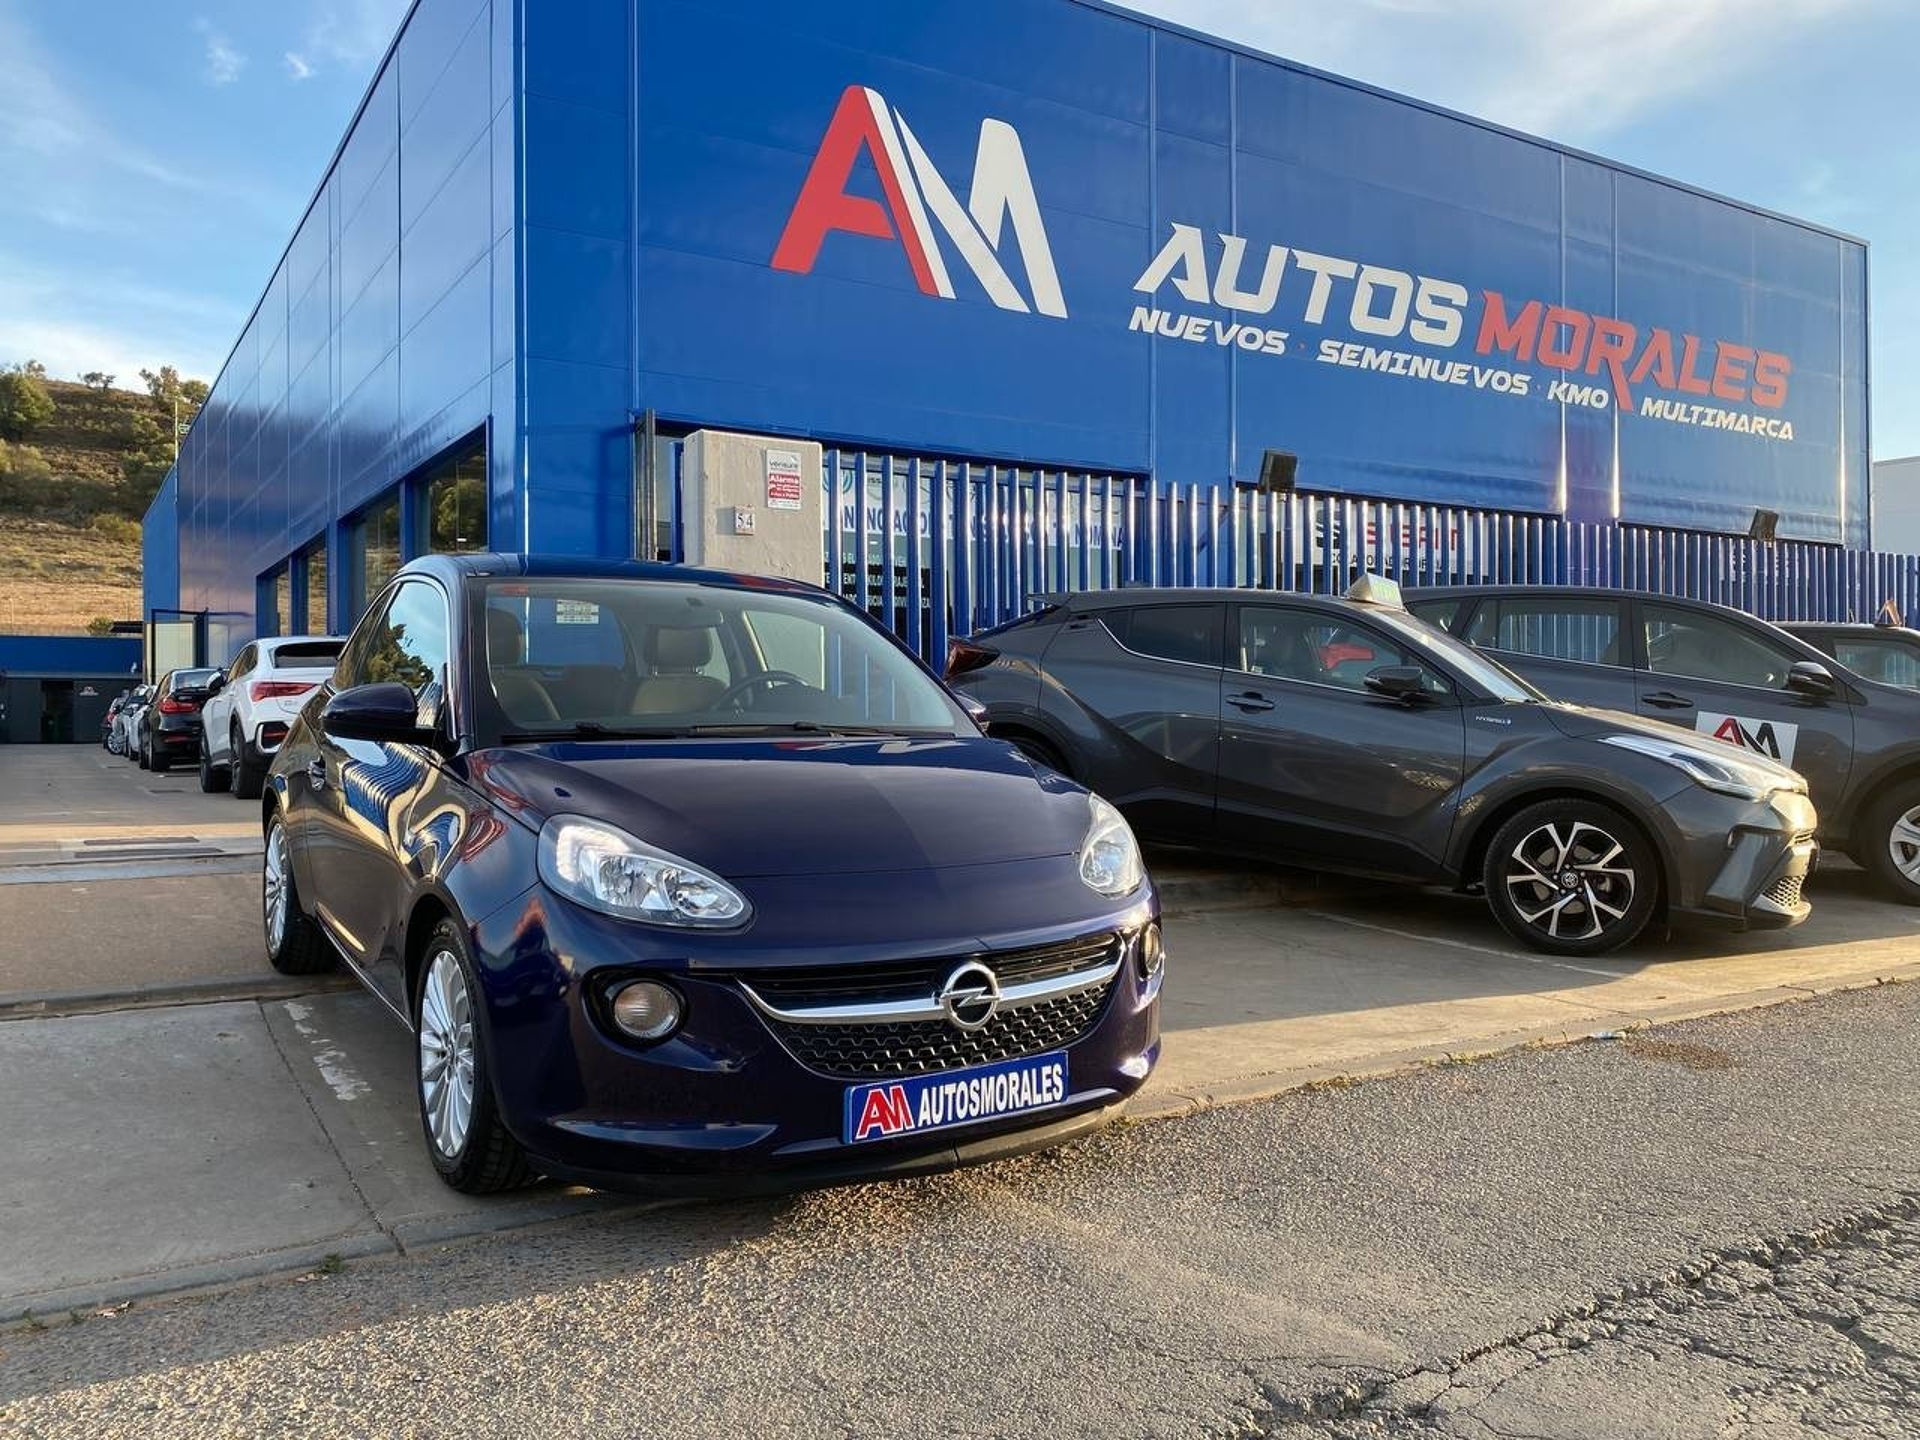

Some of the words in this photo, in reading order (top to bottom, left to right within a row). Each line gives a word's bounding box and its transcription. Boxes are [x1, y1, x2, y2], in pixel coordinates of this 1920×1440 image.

[769, 84, 1069, 318] AM
[1128, 306, 1290, 355] NUEVOS
[1316, 339, 1532, 396] SEMINUEVOS
[1640, 396, 1795, 441] MULTIMARCA
[1132, 221, 1469, 348] AUTOS
[1475, 288, 1793, 412] MORALES
[1713, 717, 1782, 761] AM
[855, 1084, 916, 1140] AM
[917, 1062, 1064, 1128] AUTOSMORALES
